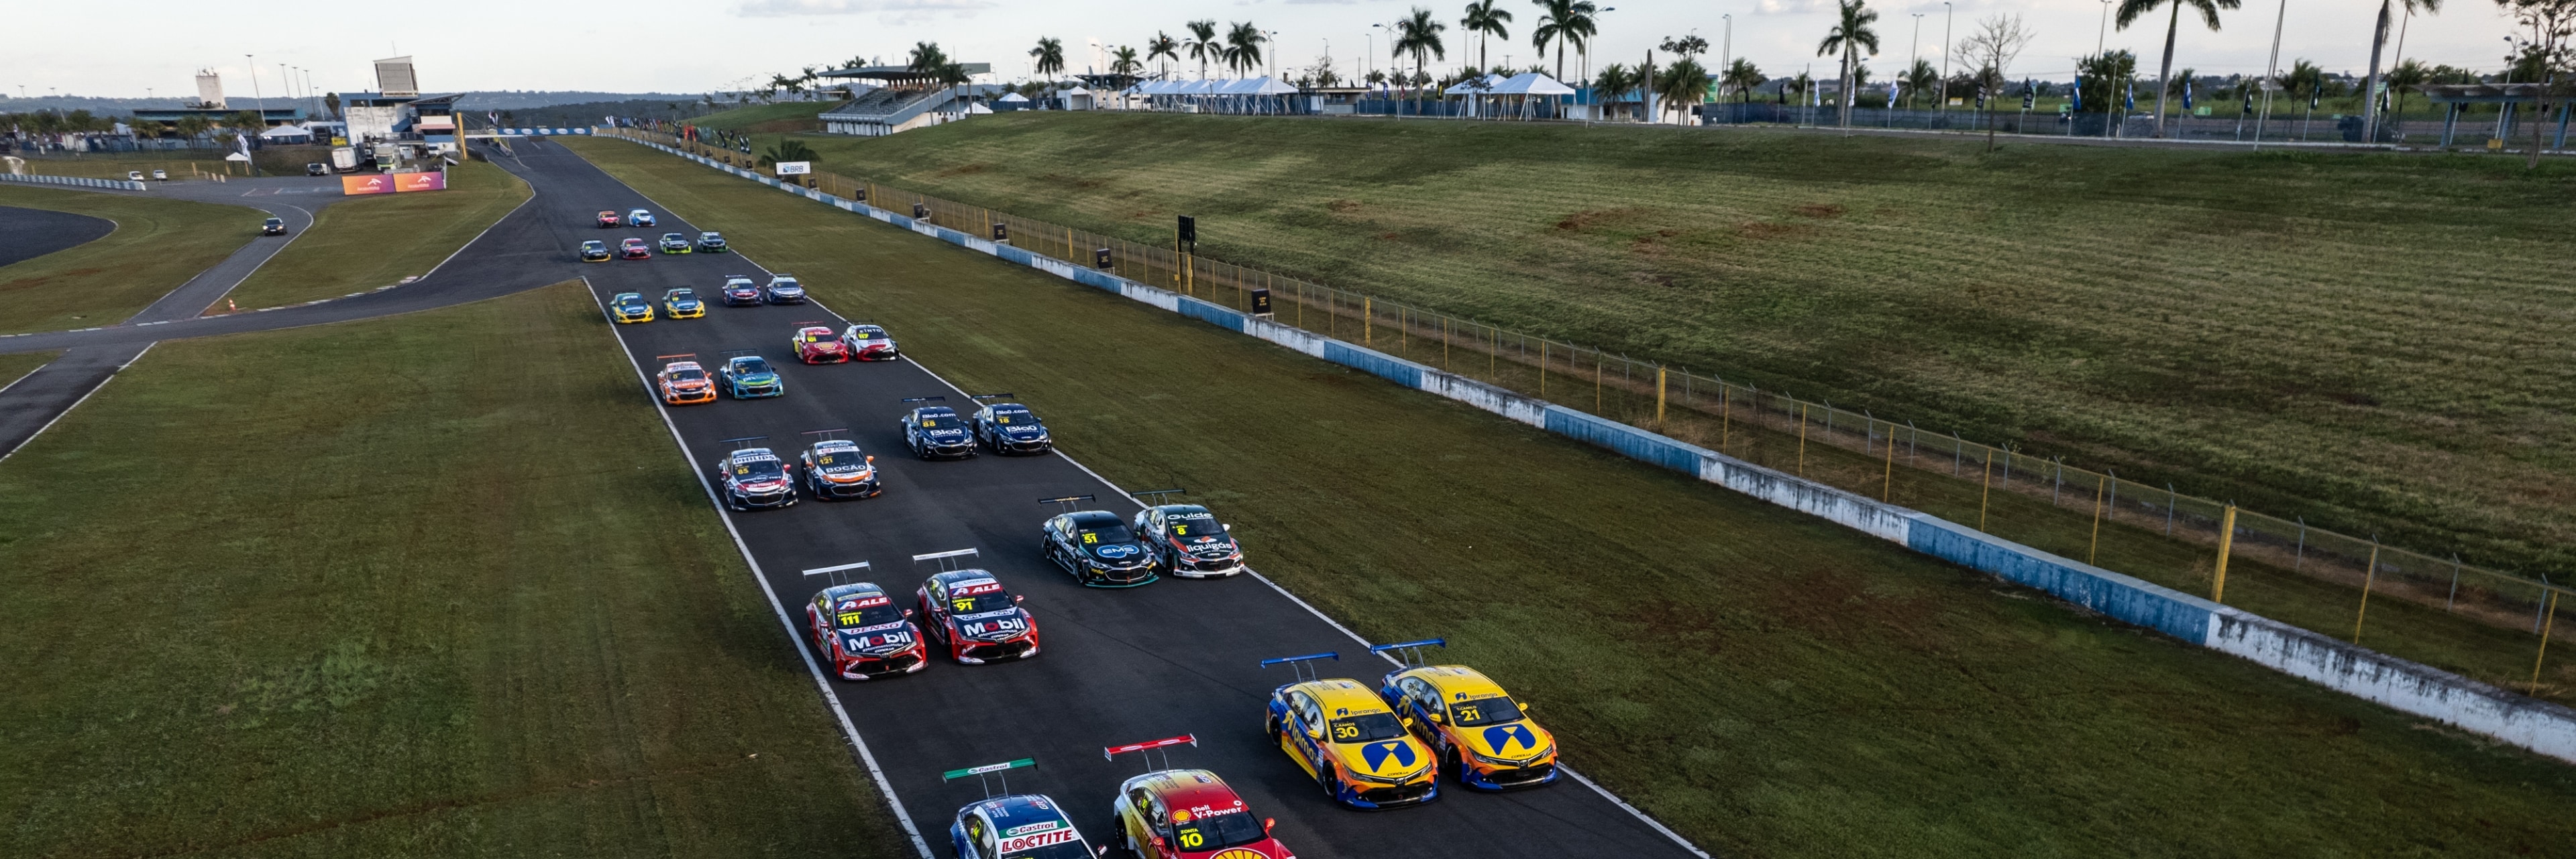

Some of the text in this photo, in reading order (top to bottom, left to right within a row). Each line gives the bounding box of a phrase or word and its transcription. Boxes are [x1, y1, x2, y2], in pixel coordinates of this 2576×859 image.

[826, 463, 866, 472] BOCÃO
[1167, 512, 1213, 520] Guide
[1177, 527, 1187, 536] 8
[1084, 535, 1098, 544] 51
[1102, 546, 1134, 554] EMS
[1186, 542, 1233, 552] liquigás
[972, 584, 1000, 593] ALE
[858, 597, 888, 607] ALE
[956, 601, 973, 611] 91
[841, 615, 859, 625] 111
[850, 623, 900, 634] DENSO
[963, 617, 1026, 637] Mobil
[848, 631, 912, 652] Mobil
[1469, 692, 1498, 700] Ipiranga
[1350, 708, 1381, 716] Ipiranga
[1460, 709, 1481, 722] 21
[1336, 726, 1359, 739] 30
[978, 764, 1008, 772] Castrol
[1191, 805, 1211, 813] Shell
[1193, 807, 1242, 819] V-Power
[1020, 822, 1055, 833] Castrol
[1002, 829, 1073, 853] LOCTITE
[1179, 832, 1203, 848] 10
